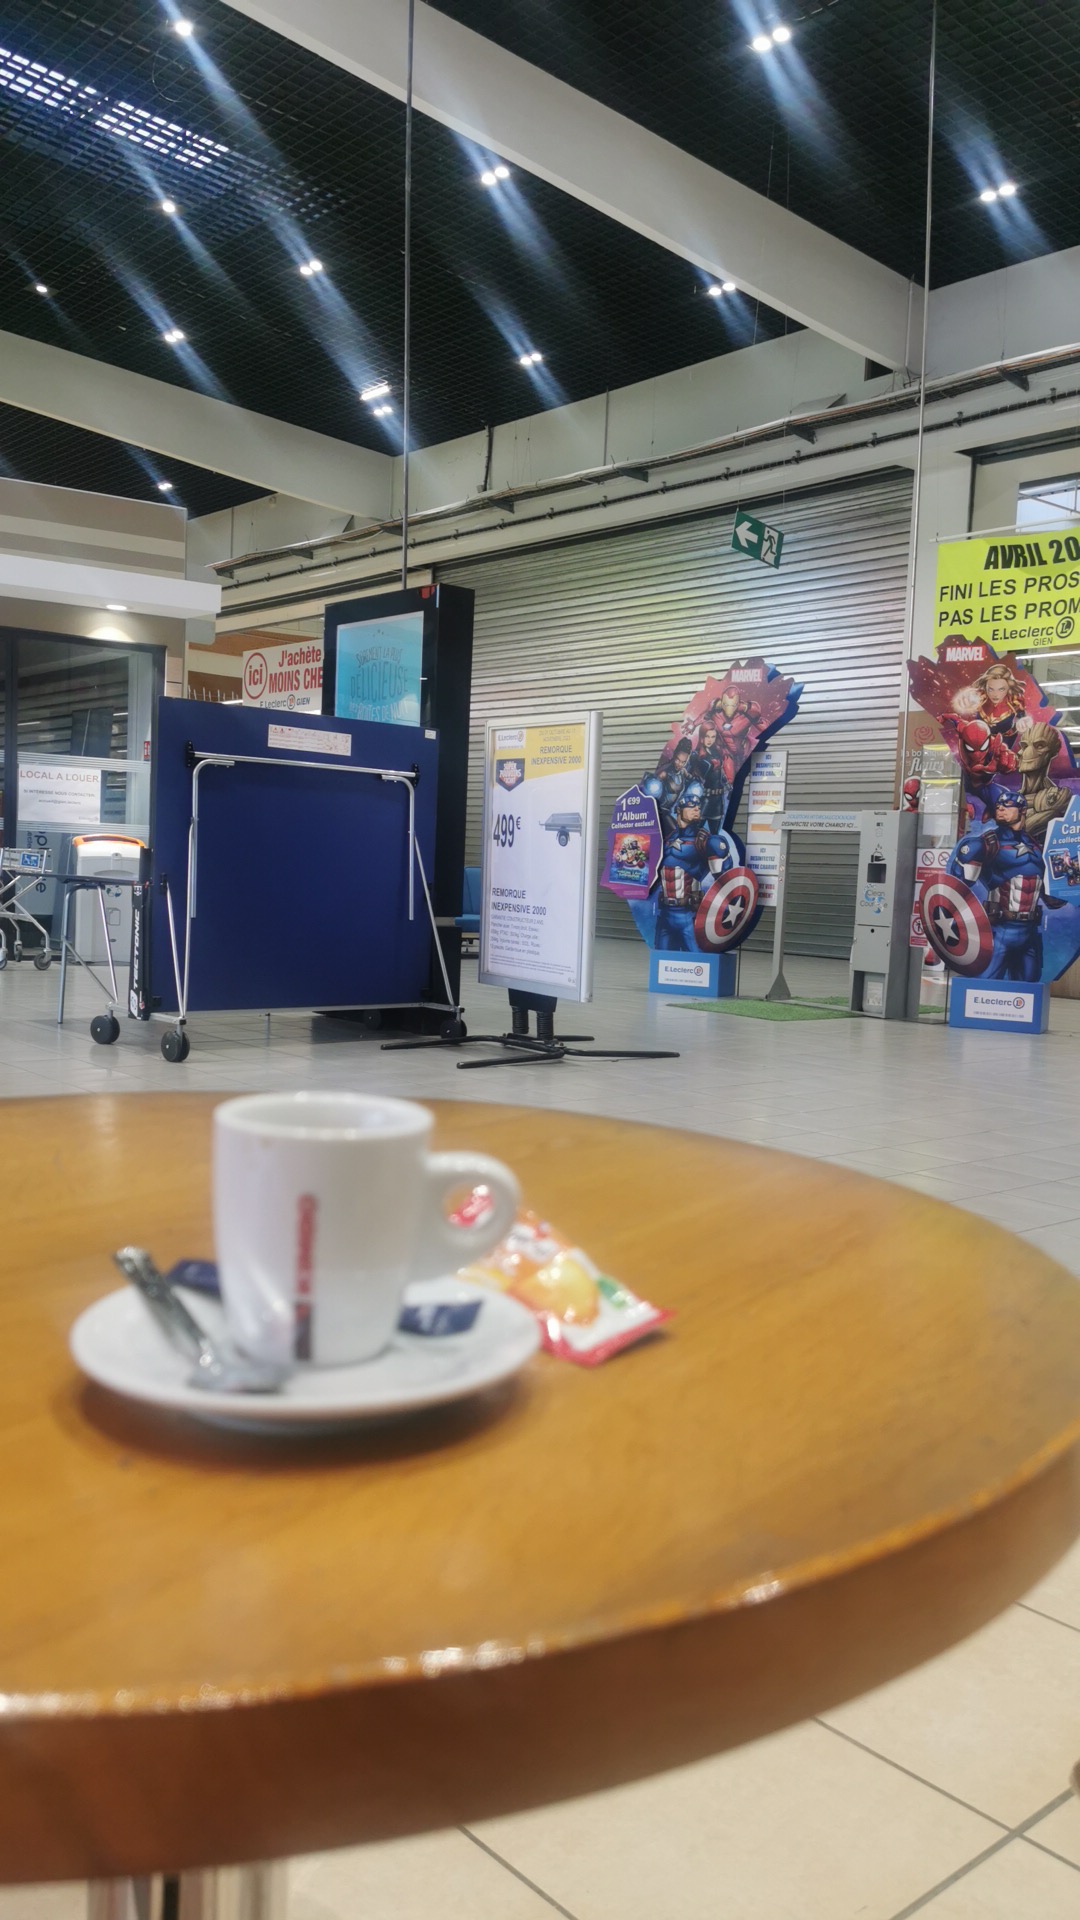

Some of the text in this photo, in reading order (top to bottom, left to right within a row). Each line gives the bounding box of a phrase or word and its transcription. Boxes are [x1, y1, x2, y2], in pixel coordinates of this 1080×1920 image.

[983, 542, 1048, 570] AVRIL
[939, 583, 973, 602] FINI
[979, 579, 1017, 598] LES
[939, 608, 973, 628] PAS
[980, 604, 1017, 623] LES
[991, 626, 1054, 641] E.Leclerc
[1033, 637, 1053, 647] GIEN
[278, 646, 322, 668] J'achète
[946, 646, 984, 661] MARVEL
[248, 663, 263, 686] ici
[268, 669, 301, 694] MOINS
[731, 668, 762, 682] MARVEL
[296, 697, 310, 706] GIEN
[540, 745, 573, 754] REMORQUE
[531, 755, 582, 766] INEXPENSIVE 2000
[20, 770, 99, 783] LOCAL A LOUER
[492, 887, 526, 899] REMORQUE
[491, 902, 547, 916] INEXPENSIVE 2000
[664, 965, 694, 974] E.Leclerc
[973, 996, 1012, 1006] E.Leclerc
